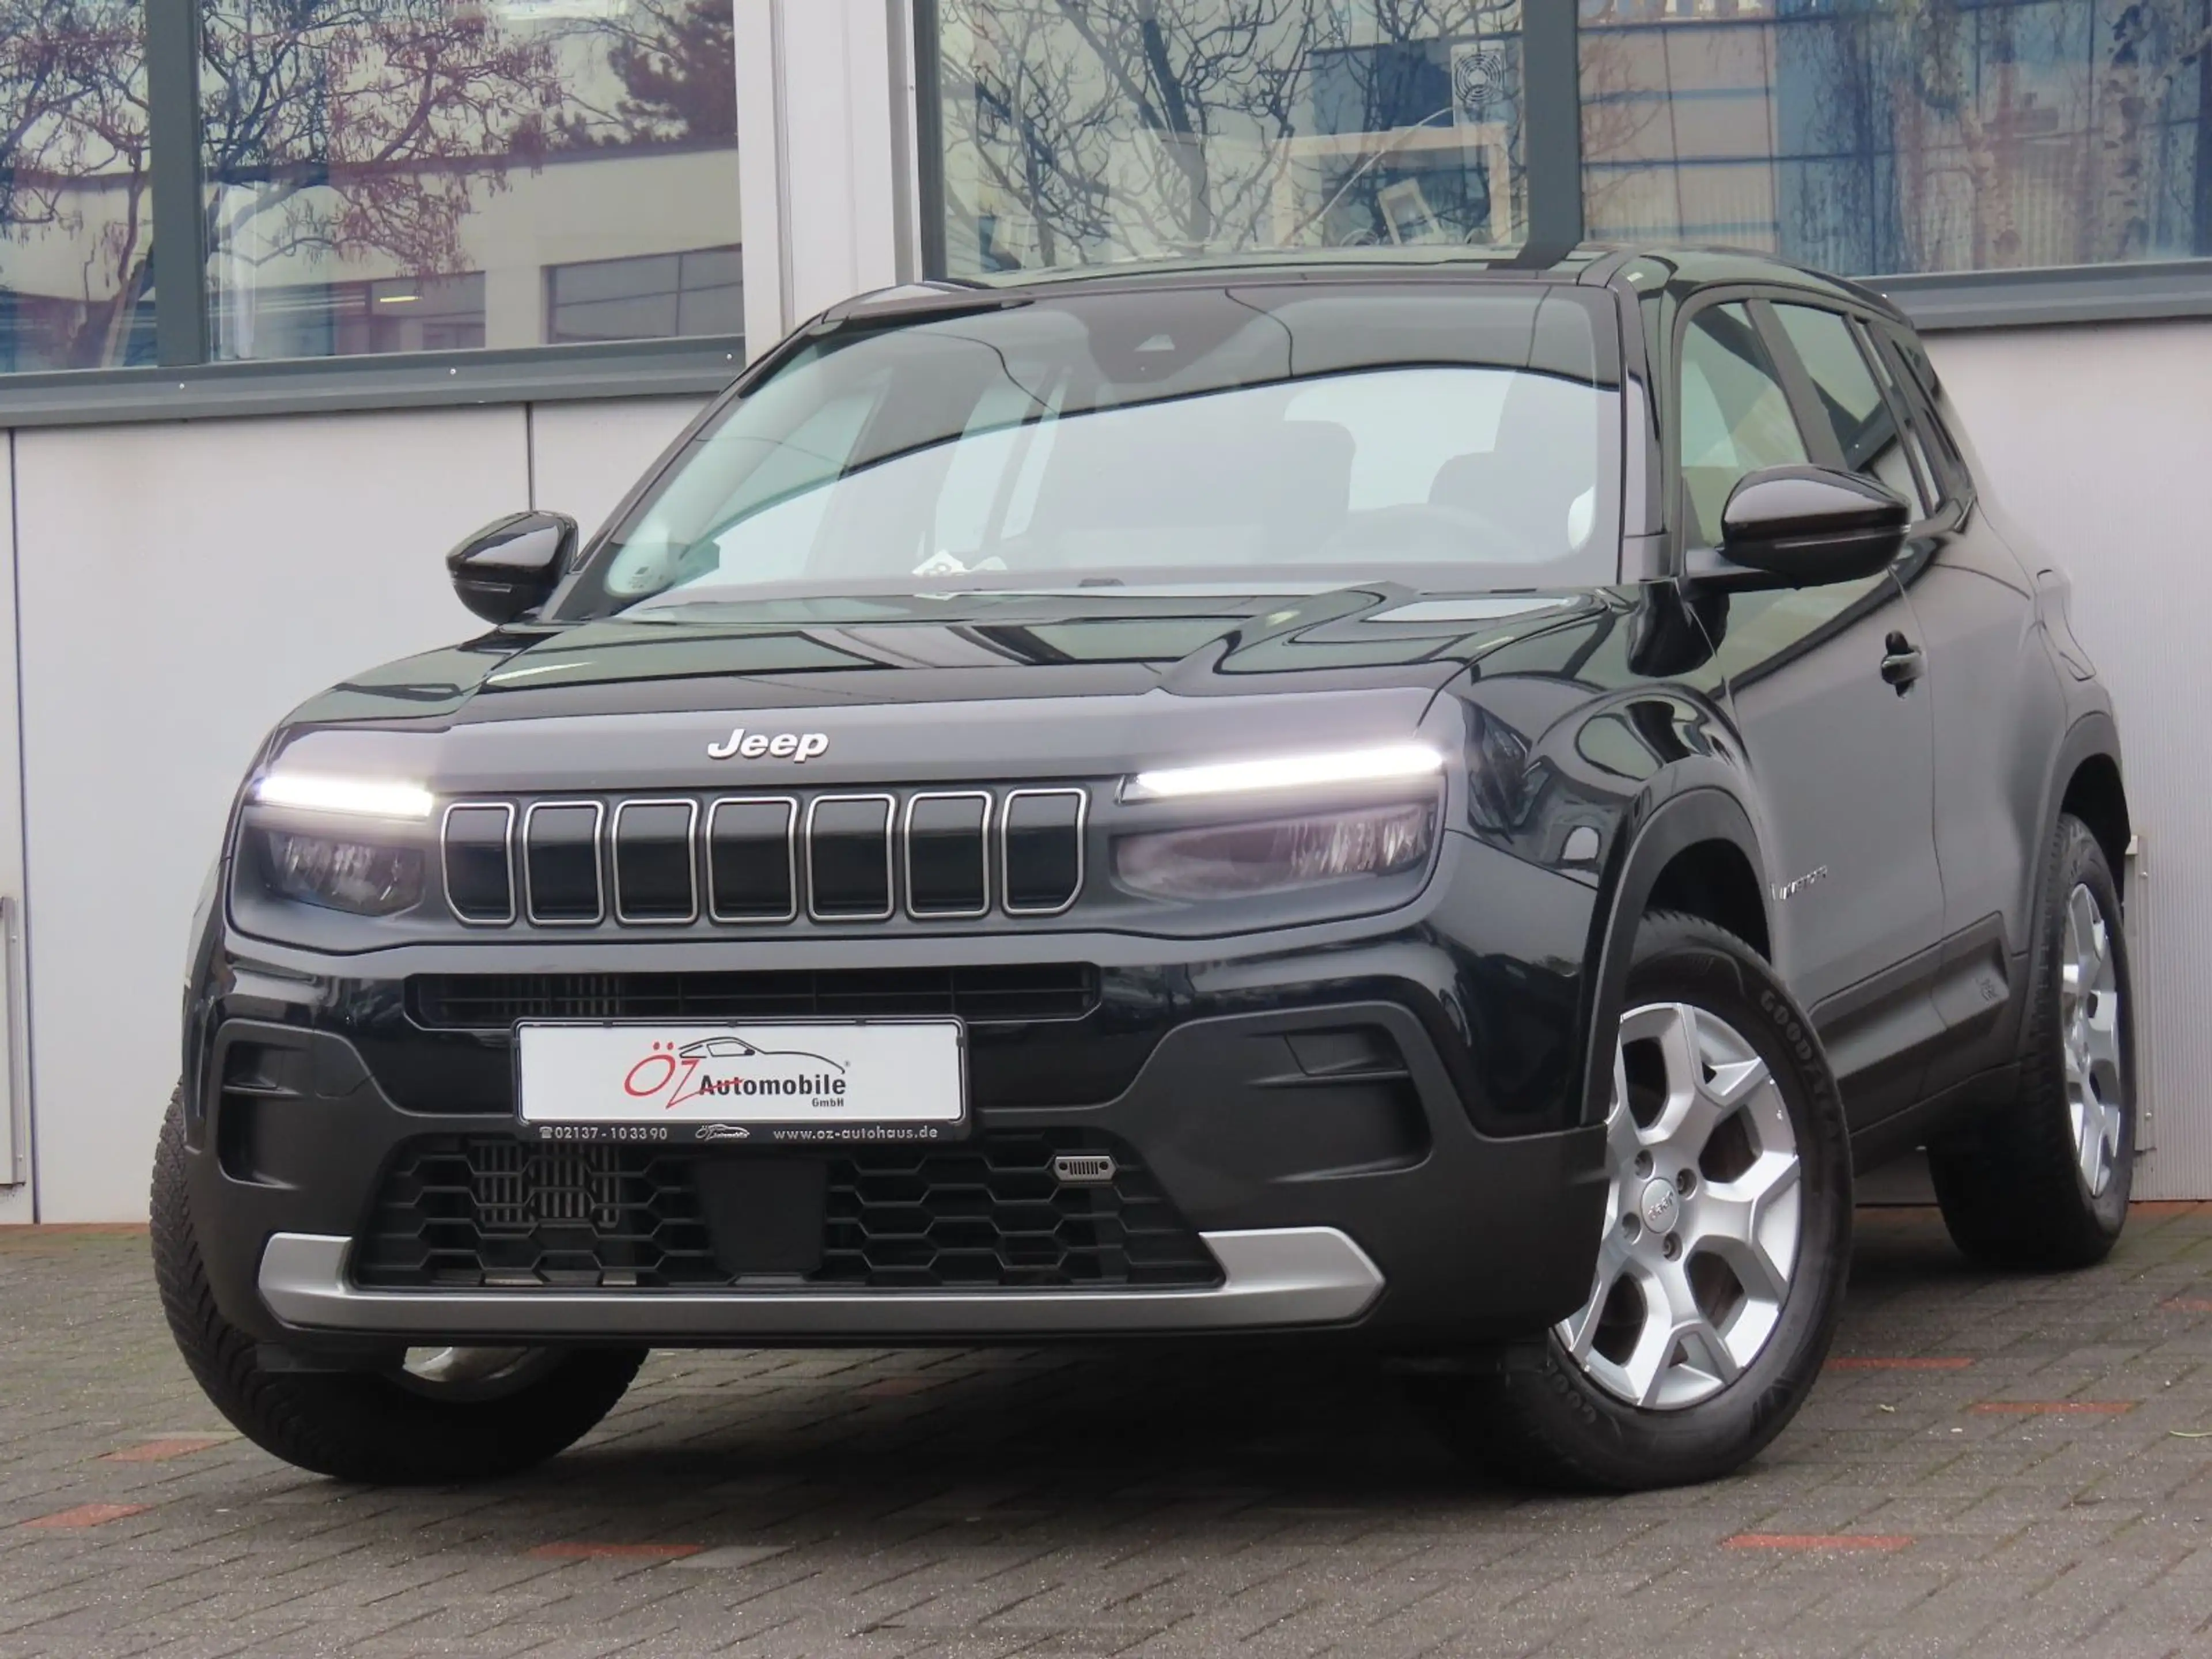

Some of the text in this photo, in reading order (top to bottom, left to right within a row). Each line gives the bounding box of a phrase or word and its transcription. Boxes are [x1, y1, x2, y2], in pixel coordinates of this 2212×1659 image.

[707, 729, 829, 763] Jeep
[624, 1041, 846, 1109] ÖZ Automobile
[811, 1098, 844, 1107] GmbH
[773, 1126, 938, 1139] www.oz-autohaus.de
